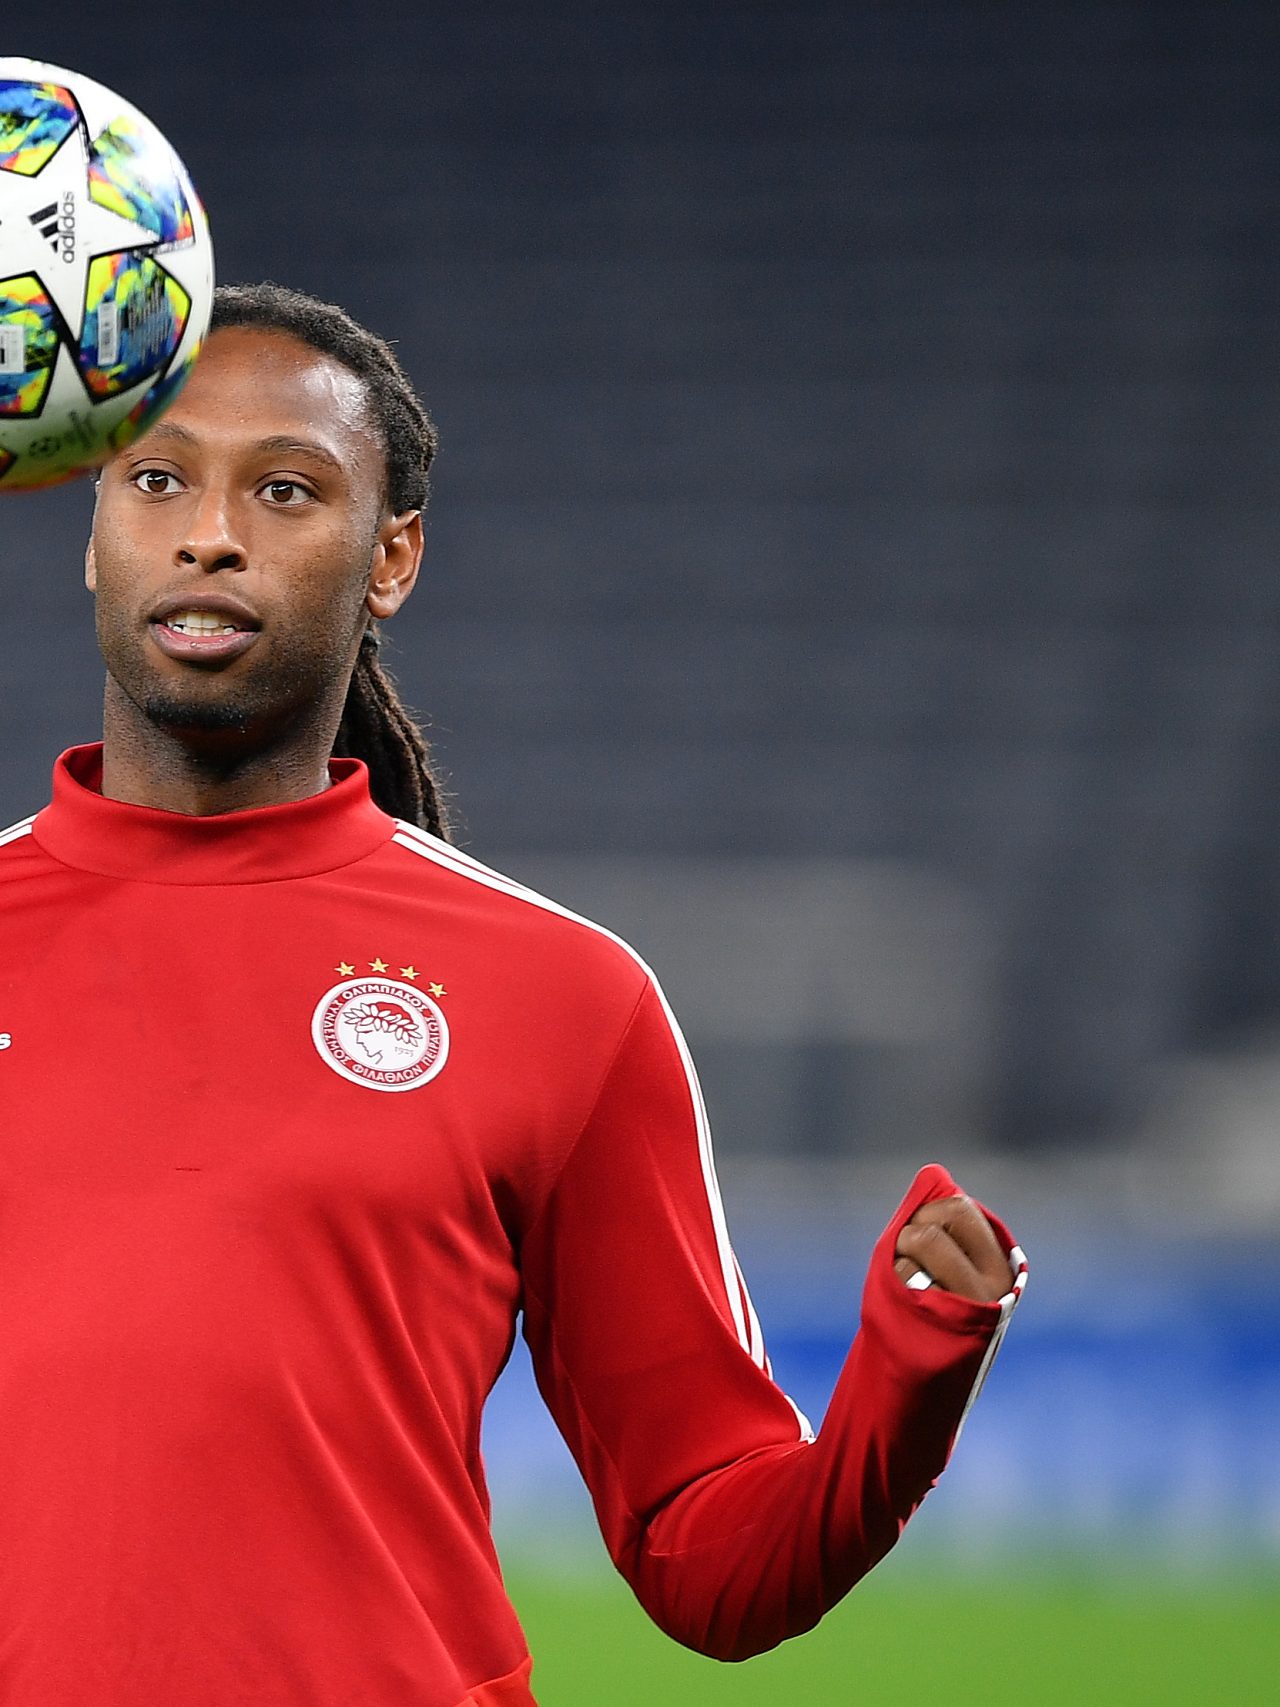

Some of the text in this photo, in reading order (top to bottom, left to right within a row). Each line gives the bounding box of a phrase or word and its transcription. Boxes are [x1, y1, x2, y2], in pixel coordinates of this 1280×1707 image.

[59, 191, 75, 264] adidas
[342, 984, 427, 1013] ΟΛΥΜΠΙΑΚΟΣ
[352, 1064, 423, 1083] ΦΙΛΑΘΛΩΝ
